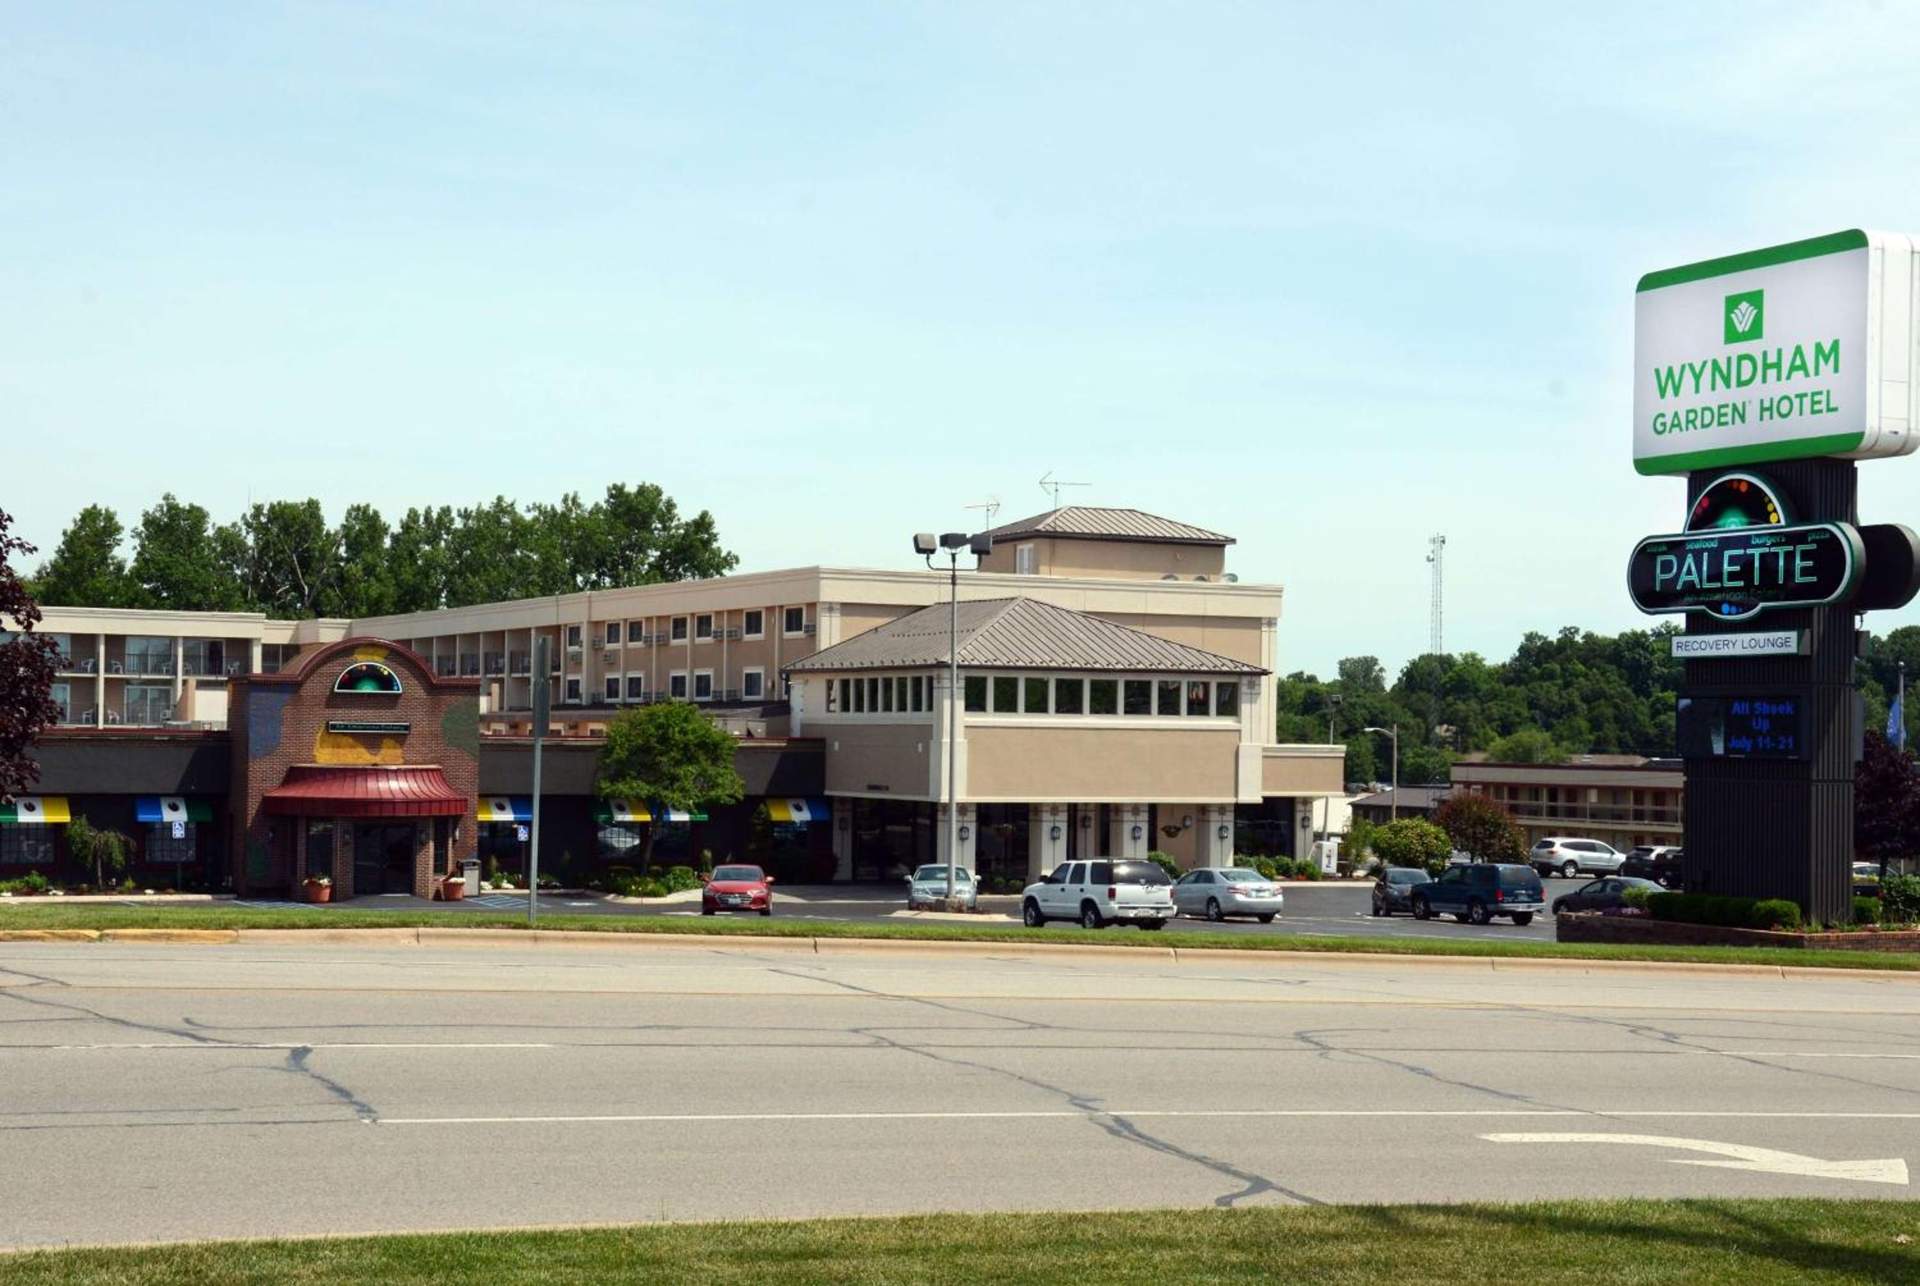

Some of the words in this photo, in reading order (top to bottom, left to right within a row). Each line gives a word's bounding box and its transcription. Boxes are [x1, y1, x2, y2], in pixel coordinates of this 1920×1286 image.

[1654, 338, 1840, 400] WYNDHAM
[1652, 401, 1747, 435] GARDEN
[1759, 389, 1839, 422] HOTEL
[1751, 534, 1785, 546] burgers
[1655, 543, 1818, 592] PALETTE
[1676, 639, 1738, 652] RECOVERY
[1741, 636, 1792, 650] LOUNGE
